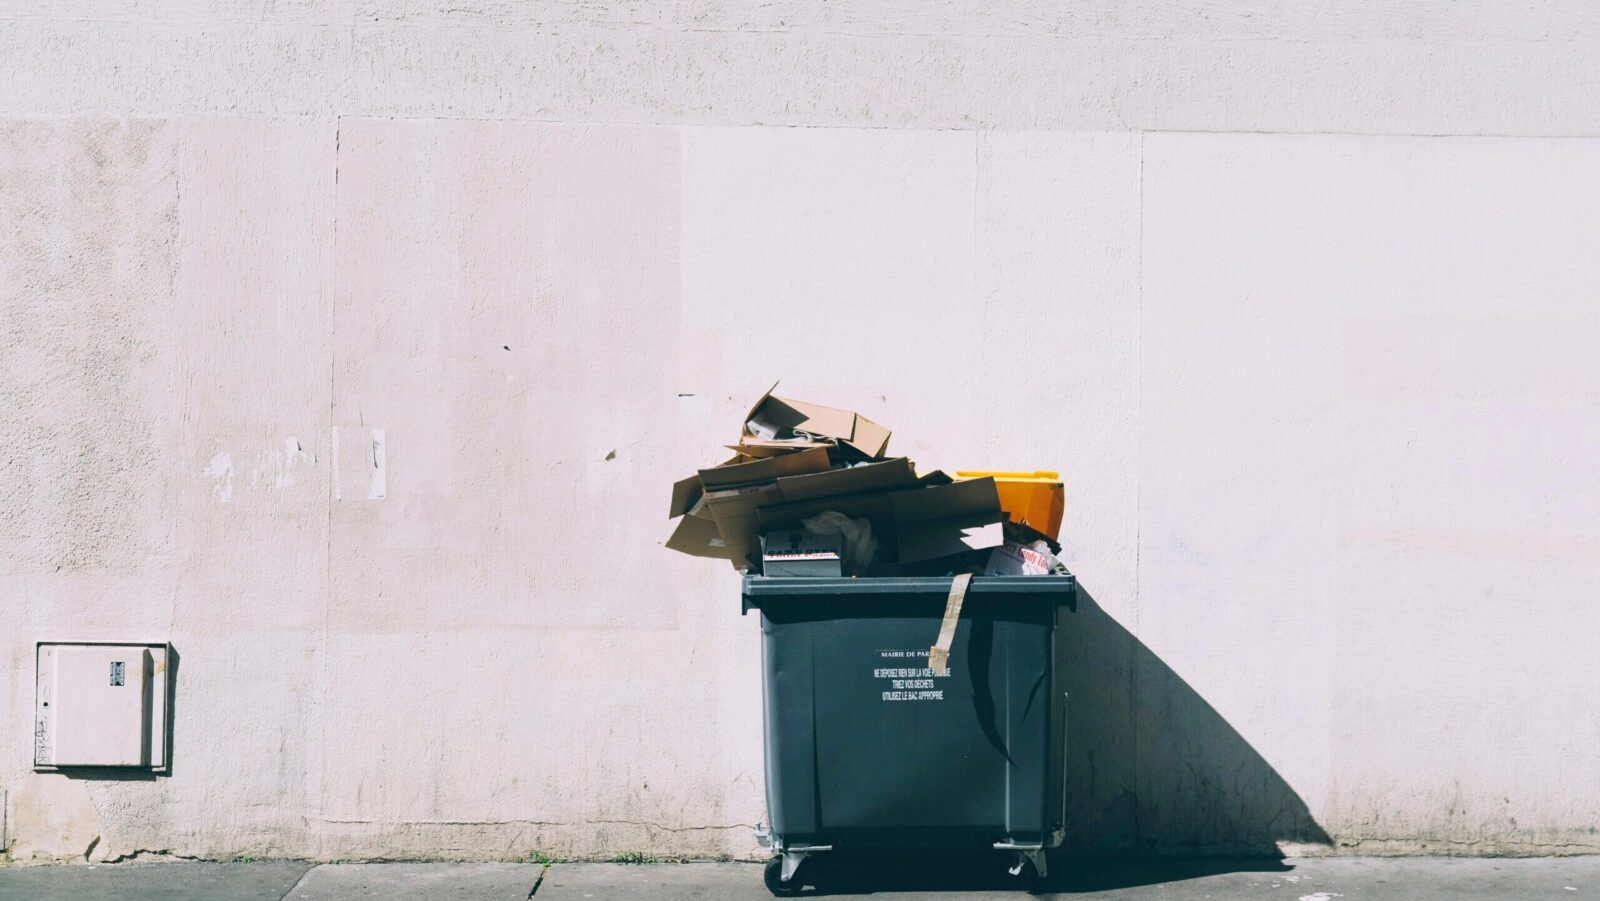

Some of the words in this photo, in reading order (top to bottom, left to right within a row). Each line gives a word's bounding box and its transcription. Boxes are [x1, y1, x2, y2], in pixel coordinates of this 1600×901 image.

[874, 668, 880, 678] NE
[880, 667, 898, 678] DÉPOSEZ
[898, 668, 907, 678] RIEN
[908, 668, 916, 678] SUR
[916, 668, 922, 677] LA
[922, 668, 931, 677] VOIE
[892, 680, 904, 689] TRIEZ
[905, 680, 914, 689] VOS
[914, 679, 934, 689] DÉCHETS
[882, 691, 901, 701] UTILISEZ
[901, 691, 908, 700] LE
[908, 691, 918, 700] BAC
[918, 690, 944, 700] APPROPRIÉ
